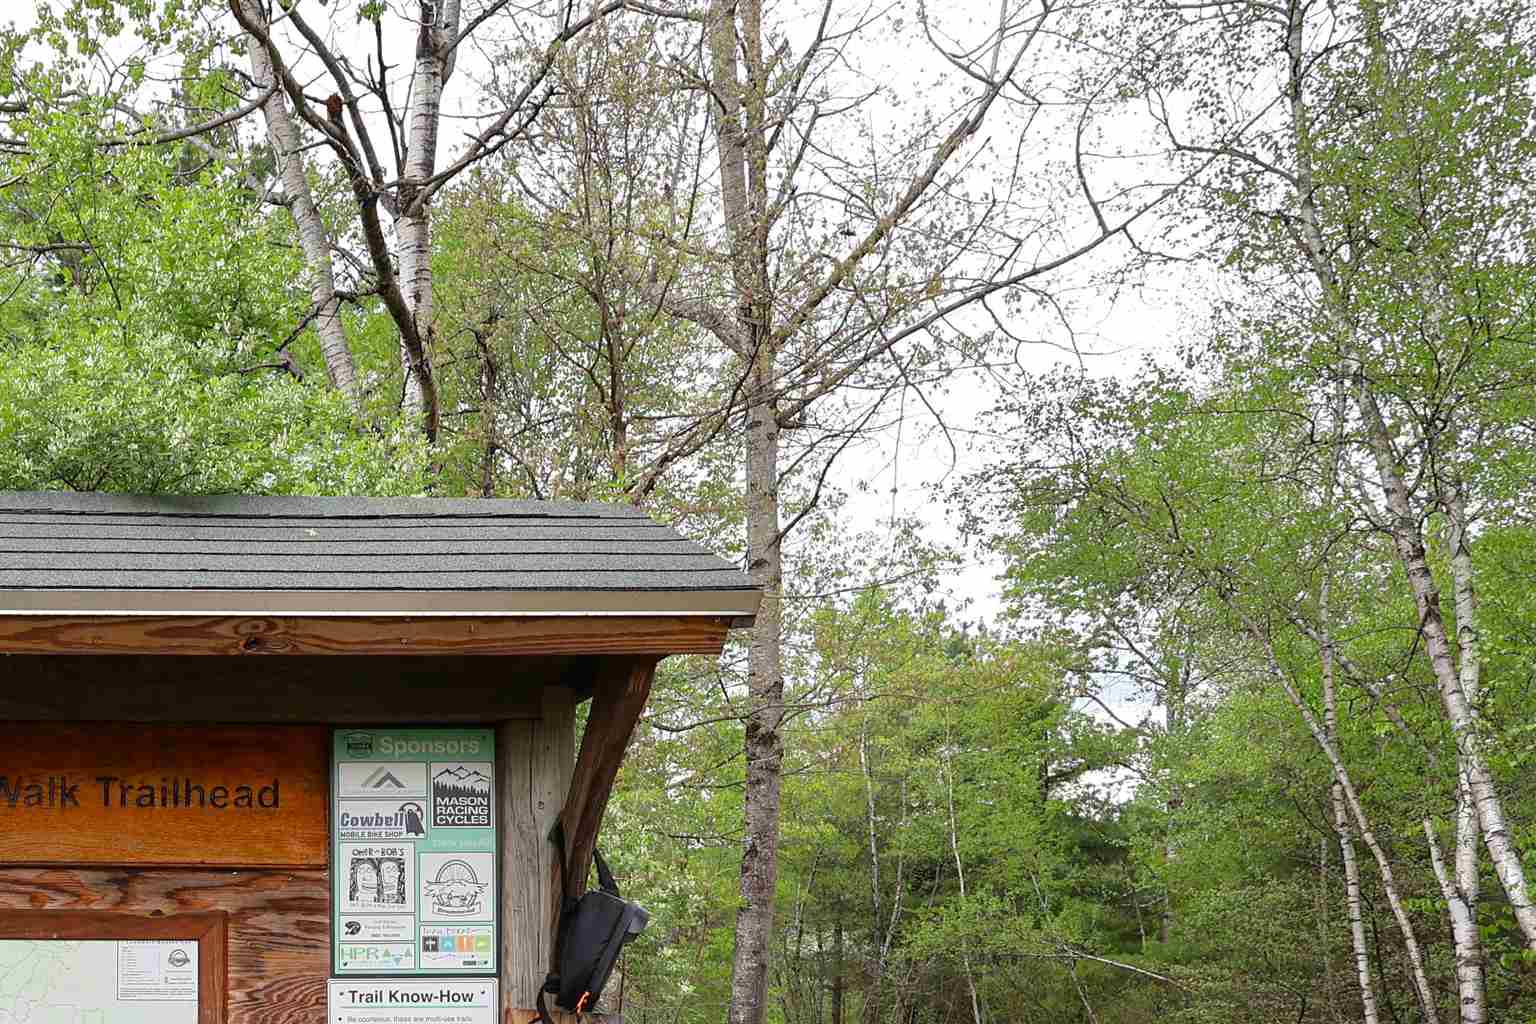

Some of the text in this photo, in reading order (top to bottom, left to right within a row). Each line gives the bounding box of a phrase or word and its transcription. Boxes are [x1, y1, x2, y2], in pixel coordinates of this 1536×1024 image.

[379, 736, 480, 758] Sponsors
[94, 776, 281, 809] Trailhead
[436, 797, 488, 806] MASON
[436, 806, 489, 815] RACING
[341, 813, 404, 827] Cowbell
[436, 815, 489, 824] CYCLES
[349, 990, 474, 1003] Trail Know-How
